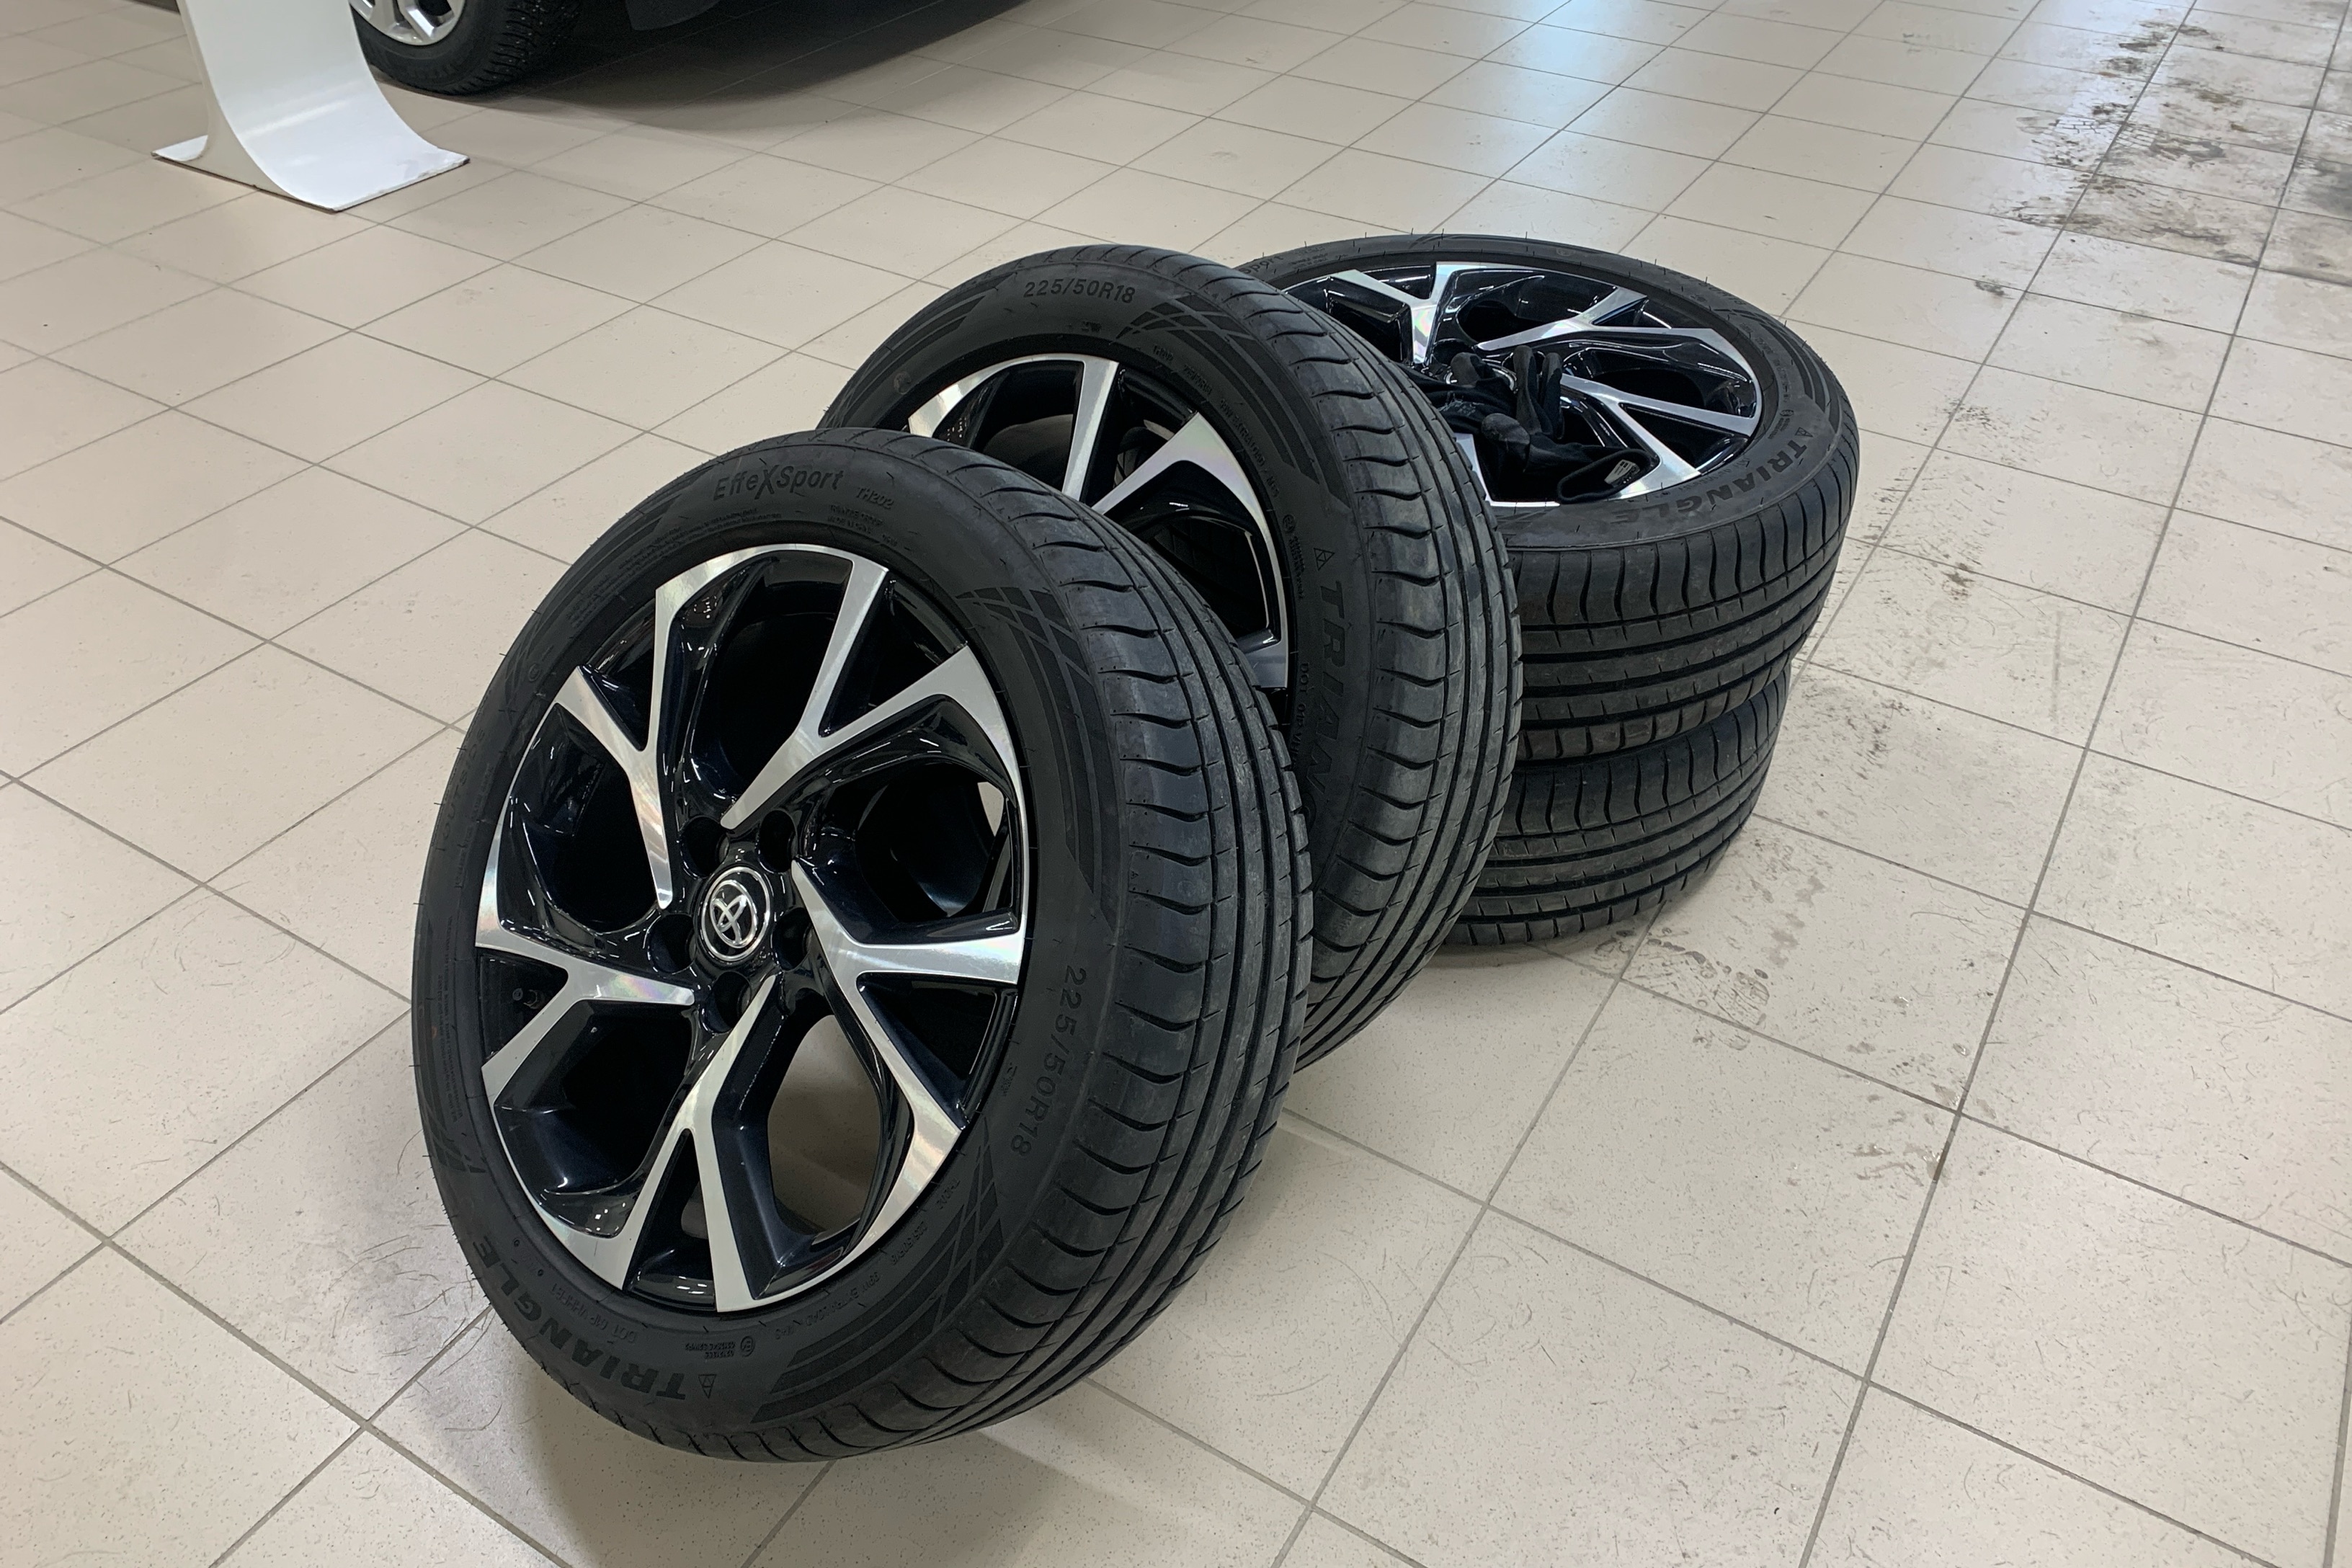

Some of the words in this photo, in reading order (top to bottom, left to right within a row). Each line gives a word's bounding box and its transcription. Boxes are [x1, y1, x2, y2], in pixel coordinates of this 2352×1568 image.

[1023, 277, 1136, 304] 225/50R18
[713, 464, 845, 501] EffeXSport
[855, 486, 896, 511] TH202
[1609, 438, 1809, 525] TRIANGLE
[1300, 662, 1309, 695] DOT
[1304, 580, 1345, 811] TRIAN
[1010, 963, 1088, 1157] 225/50R18
[470, 1239, 687, 1401] TRIANGLE
